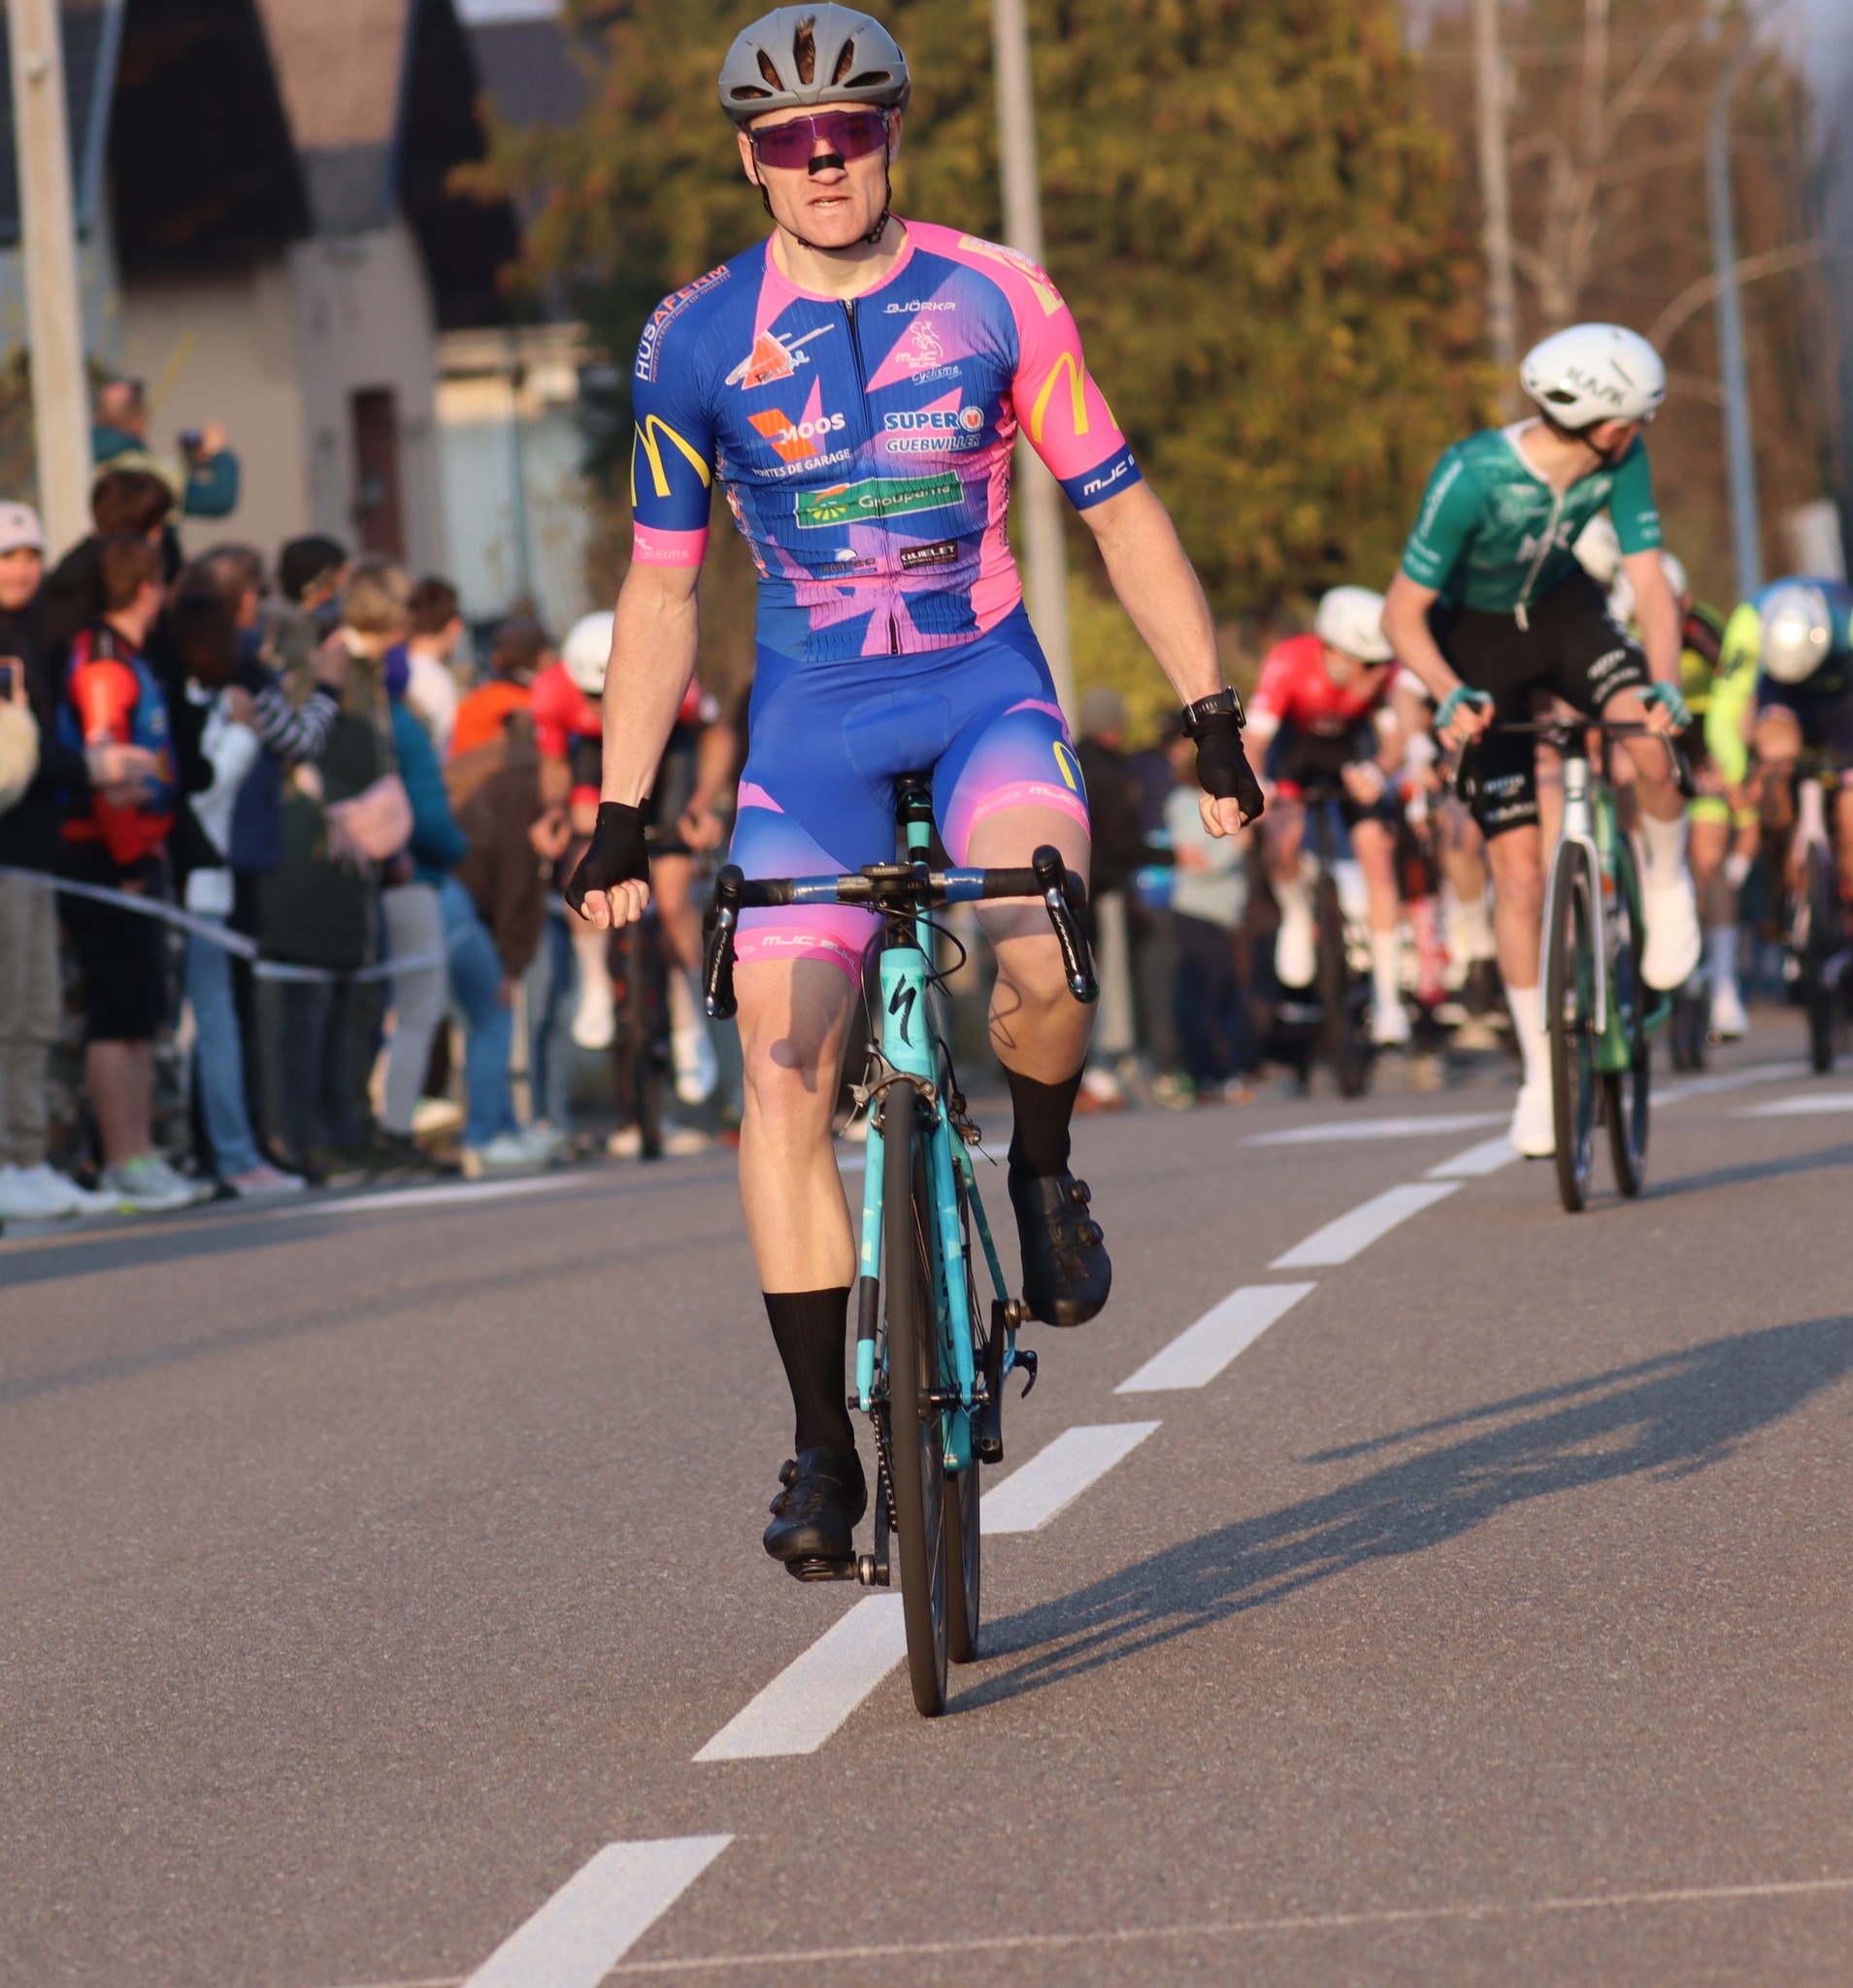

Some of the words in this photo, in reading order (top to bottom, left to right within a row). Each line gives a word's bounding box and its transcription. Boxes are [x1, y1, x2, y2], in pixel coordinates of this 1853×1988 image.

[882, 299, 956, 314] BJÖRKA
[895, 350, 938, 363] MJC
[778, 412, 846, 446] MOOS
[883, 411, 960, 432] SUPER
[886, 434, 981, 453] GUEBWILLER
[751, 467, 786, 479] PORTES
[787, 462, 804, 476] DE
[805, 447, 851, 471] GARAGE
[1083, 460, 1128, 496] MJC
[762, 935, 815, 946] MJC
